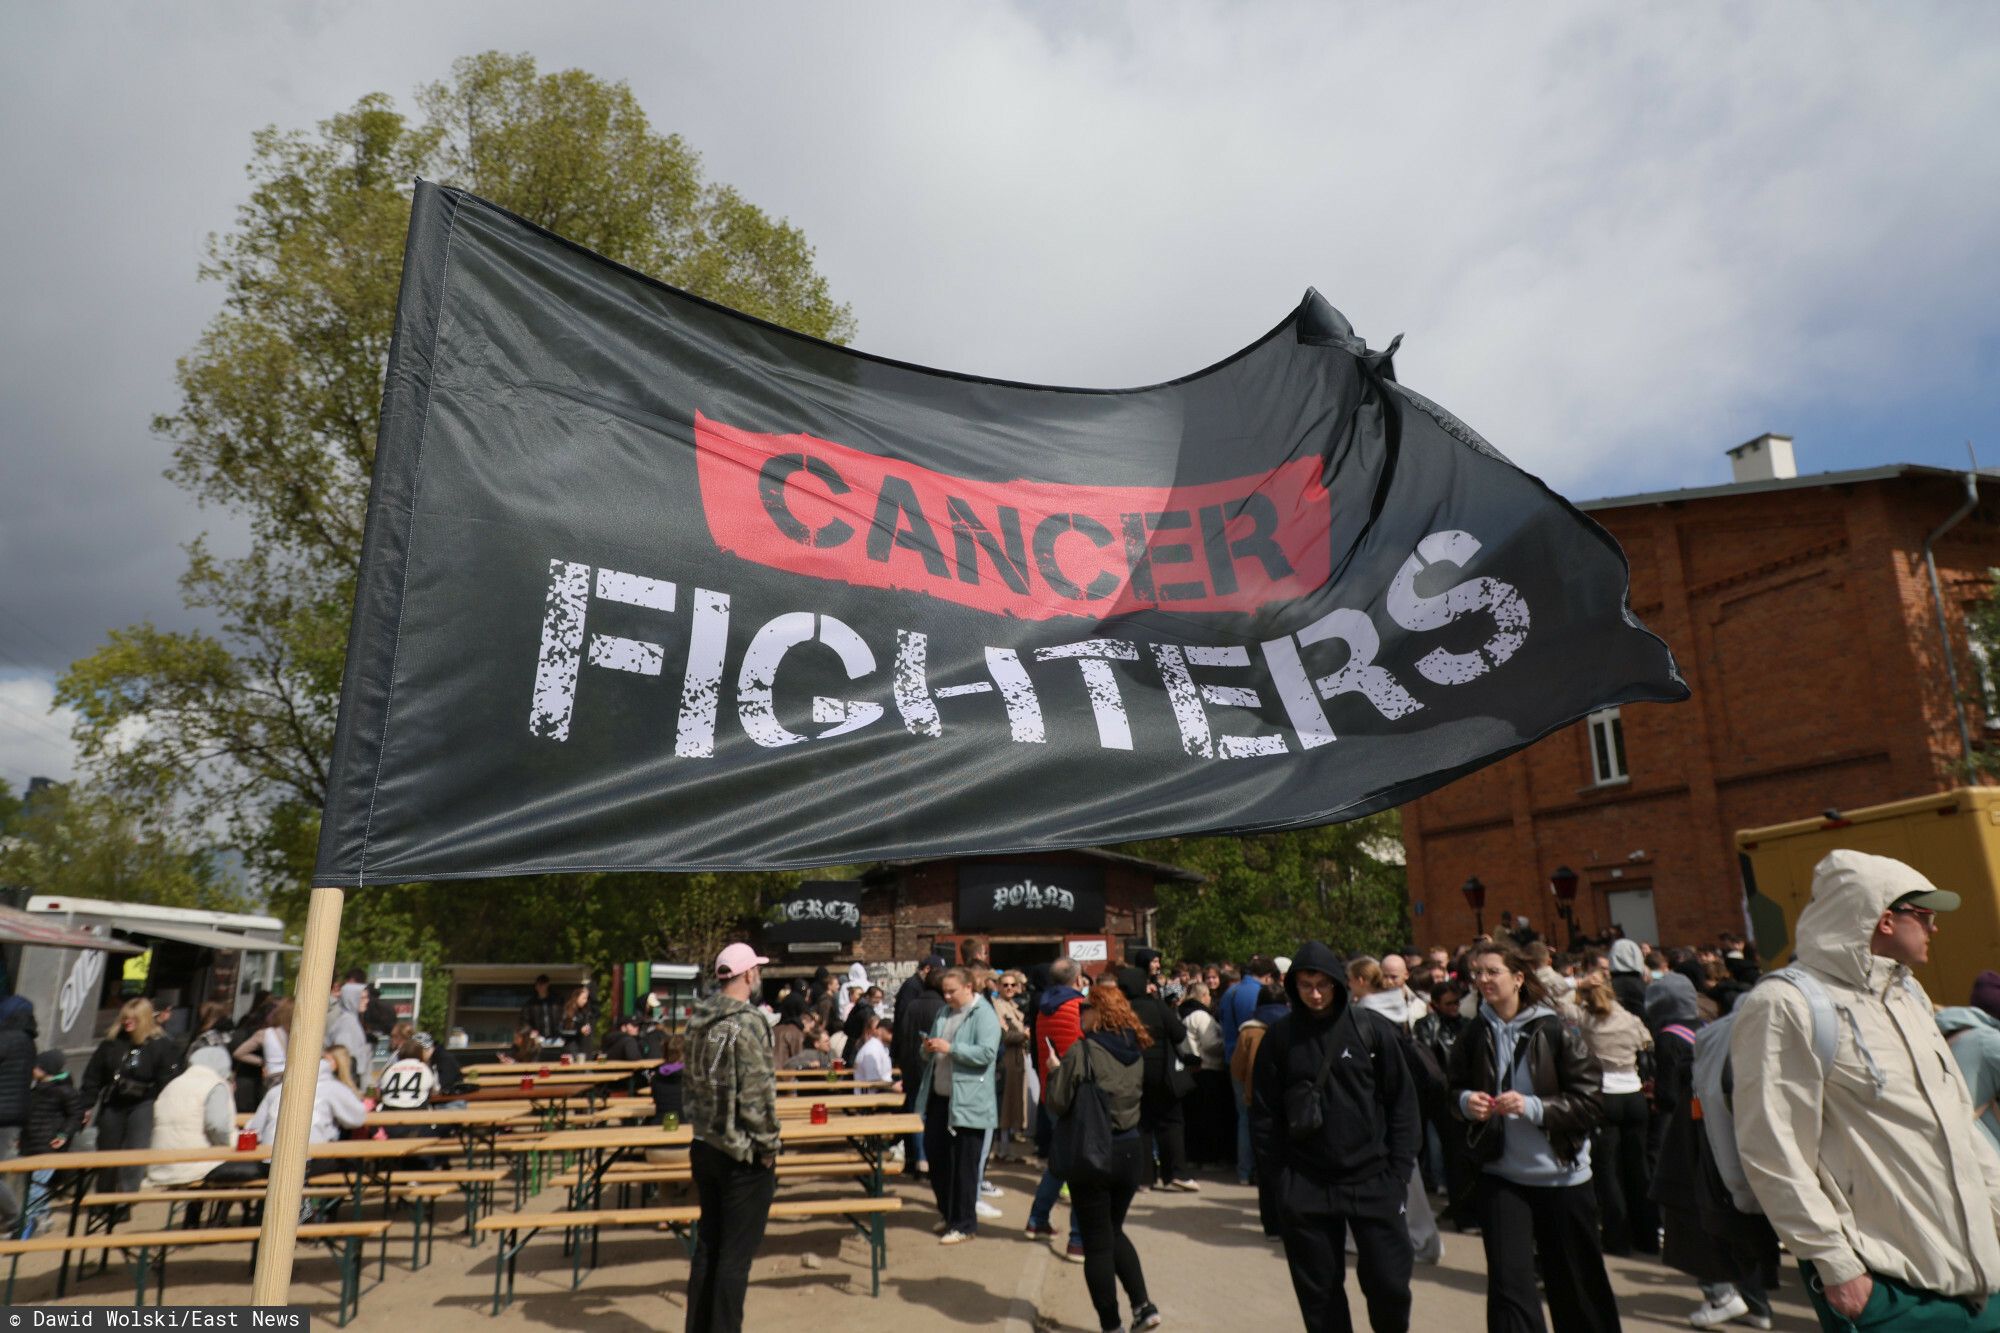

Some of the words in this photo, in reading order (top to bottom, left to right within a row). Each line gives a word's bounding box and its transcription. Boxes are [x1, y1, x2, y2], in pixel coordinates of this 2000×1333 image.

[757, 452, 1293, 601] CANCER
[529, 528, 1530, 760] FIGHTERS
[383, 1072, 422, 1099] 44
